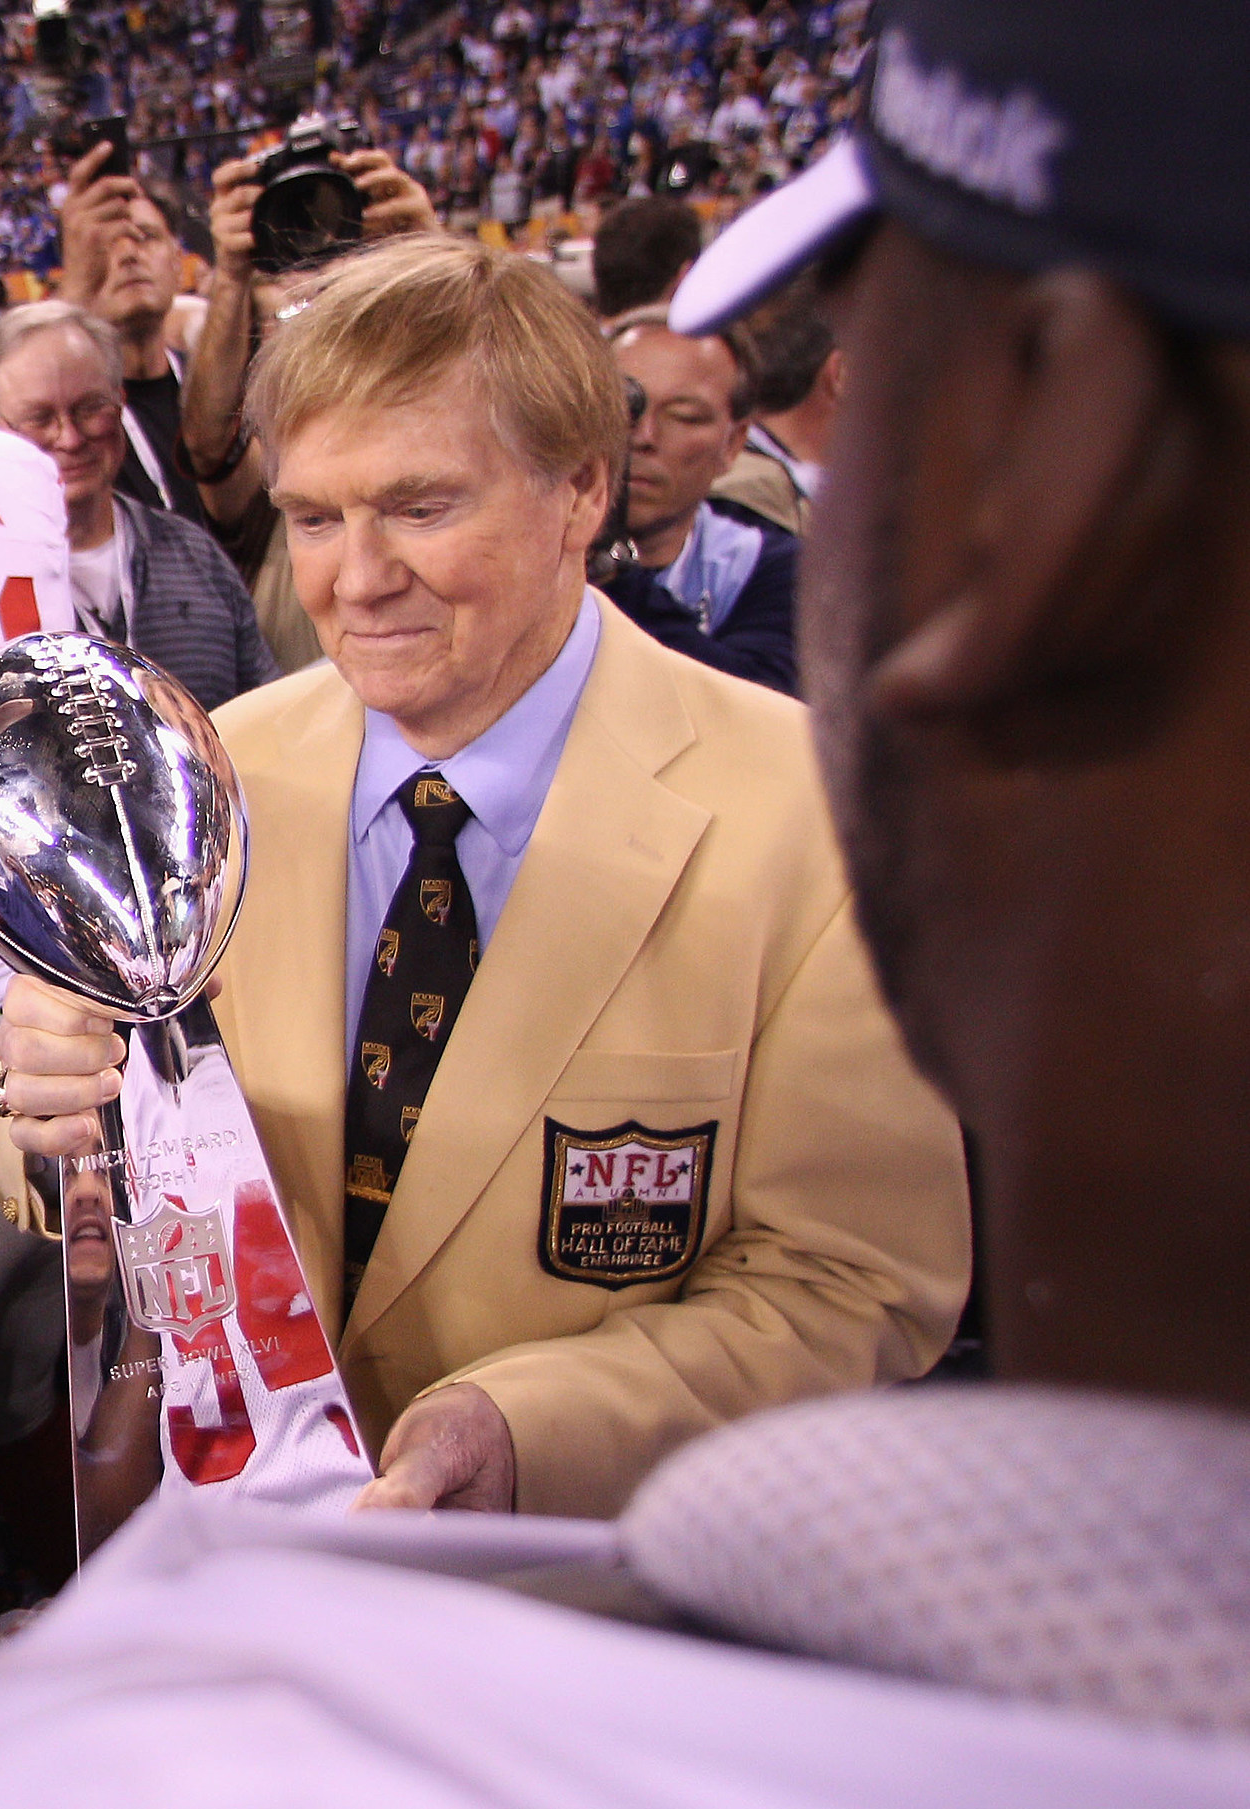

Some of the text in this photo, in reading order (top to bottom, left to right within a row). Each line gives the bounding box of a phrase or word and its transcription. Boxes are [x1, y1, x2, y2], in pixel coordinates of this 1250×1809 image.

[71, 1128, 243, 1173] VINCE LOMBARDI
[119, 1166, 199, 1195] TROPHY
[584, 1153, 680, 1188] NFL
[573, 1187, 680, 1200] ALUMNI
[571, 1219, 678, 1236] PRO FOOTBALL
[560, 1235, 684, 1255] HALL OF FAME
[579, 1251, 664, 1268] ENSHRINEE
[134, 1255, 227, 1320] NFL
[109, 1335, 281, 1382] SUPER BOWL XLVI
